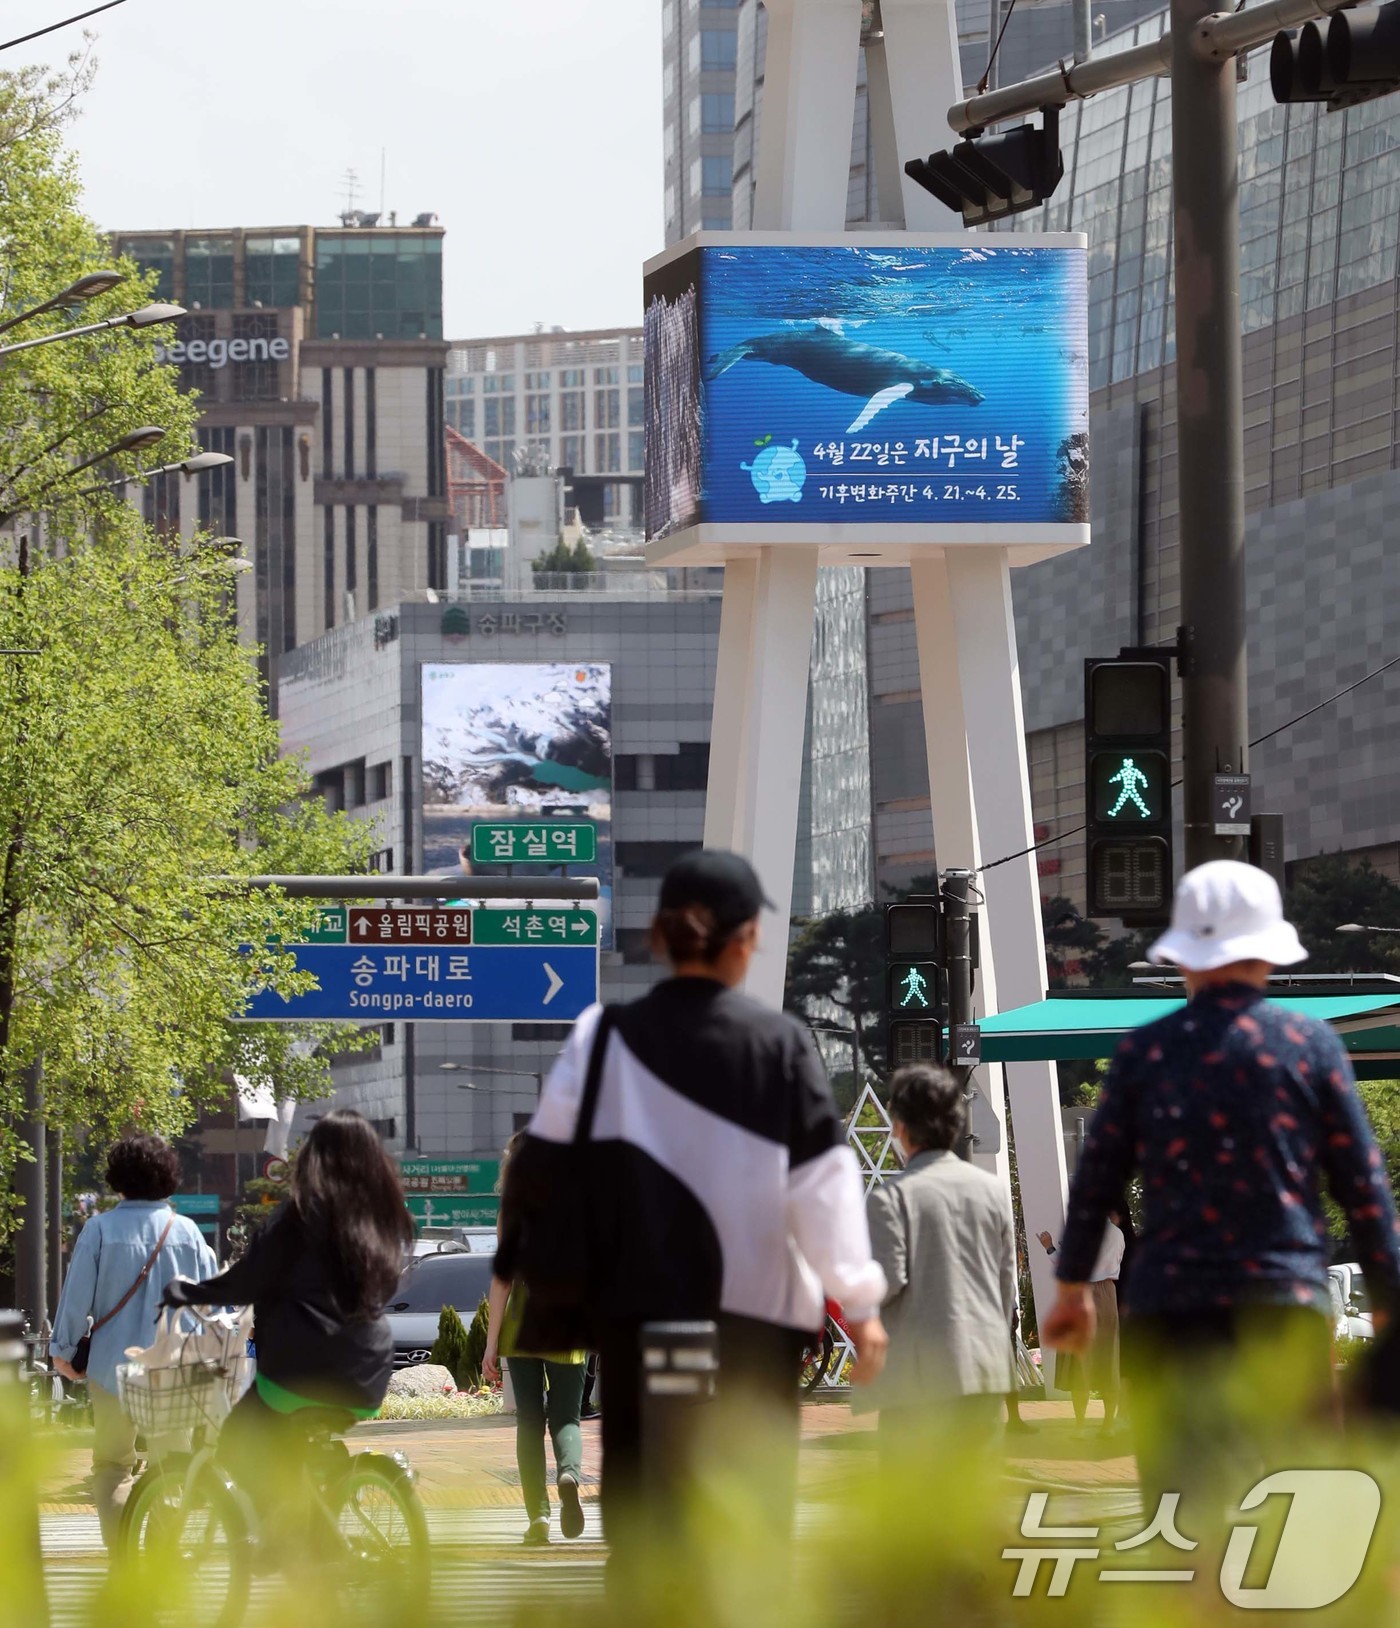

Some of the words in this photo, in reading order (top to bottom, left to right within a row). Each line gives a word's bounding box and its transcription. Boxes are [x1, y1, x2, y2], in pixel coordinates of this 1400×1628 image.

[813, 443, 844, 466] 4월
[849, 442, 908, 466] 22일은
[914, 434, 987, 468] 지구의
[995, 434, 1024, 469] 날
[819, 484, 917, 504] 기후변화주간
[922, 486, 938, 501] 4.
[996, 486, 1021, 501] 25.
[489, 829, 577, 857] 잠실역
[377, 913, 469, 938] 올림픽공원
[502, 915, 567, 938] 석촌역
[350, 955, 472, 986] 송파대로
[349, 990, 473, 1010] Songpa-daero
